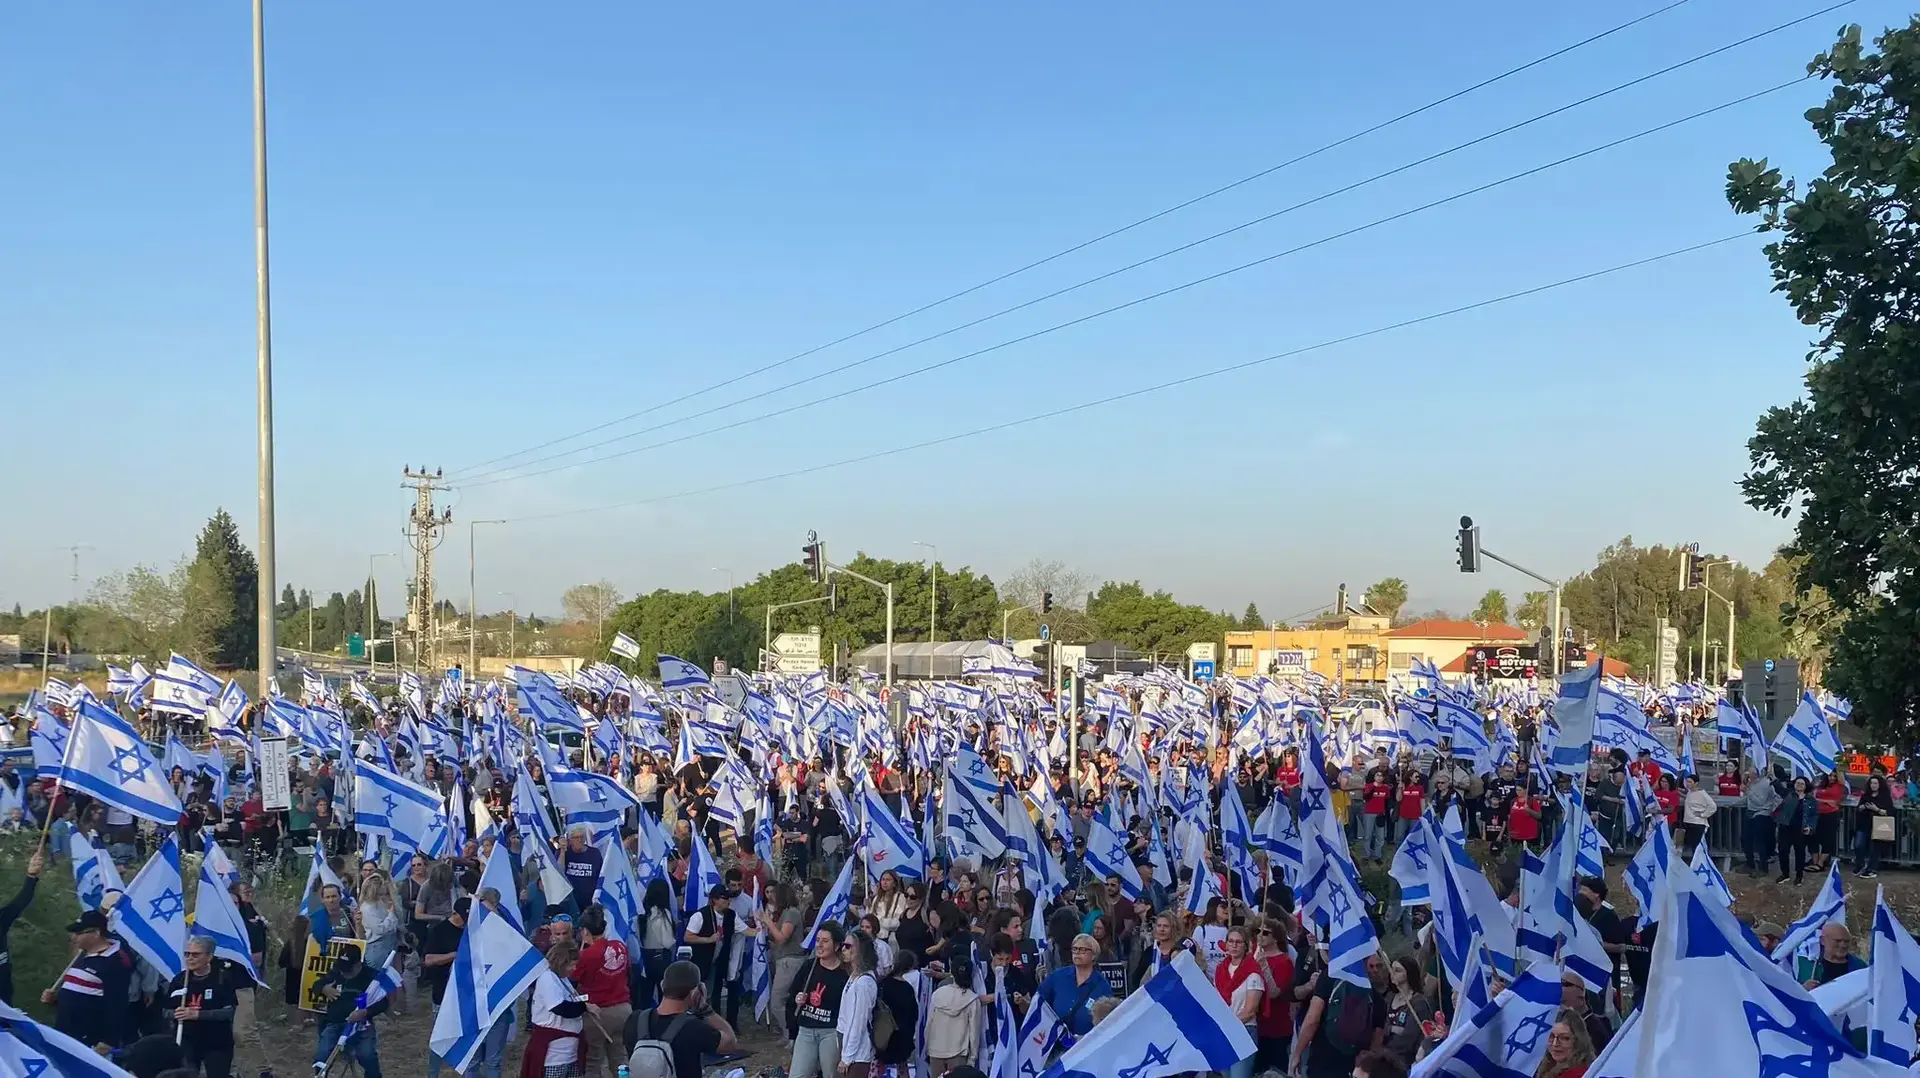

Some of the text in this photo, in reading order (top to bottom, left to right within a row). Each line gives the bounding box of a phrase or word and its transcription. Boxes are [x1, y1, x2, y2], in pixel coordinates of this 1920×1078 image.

[1279, 653, 1302, 665] אלבר
[1499, 659, 1539, 667] MOTORS
[1209, 941, 1216, 950] I
[1112, 970, 1123, 979] אין
[1110, 980, 1123, 988] עם
